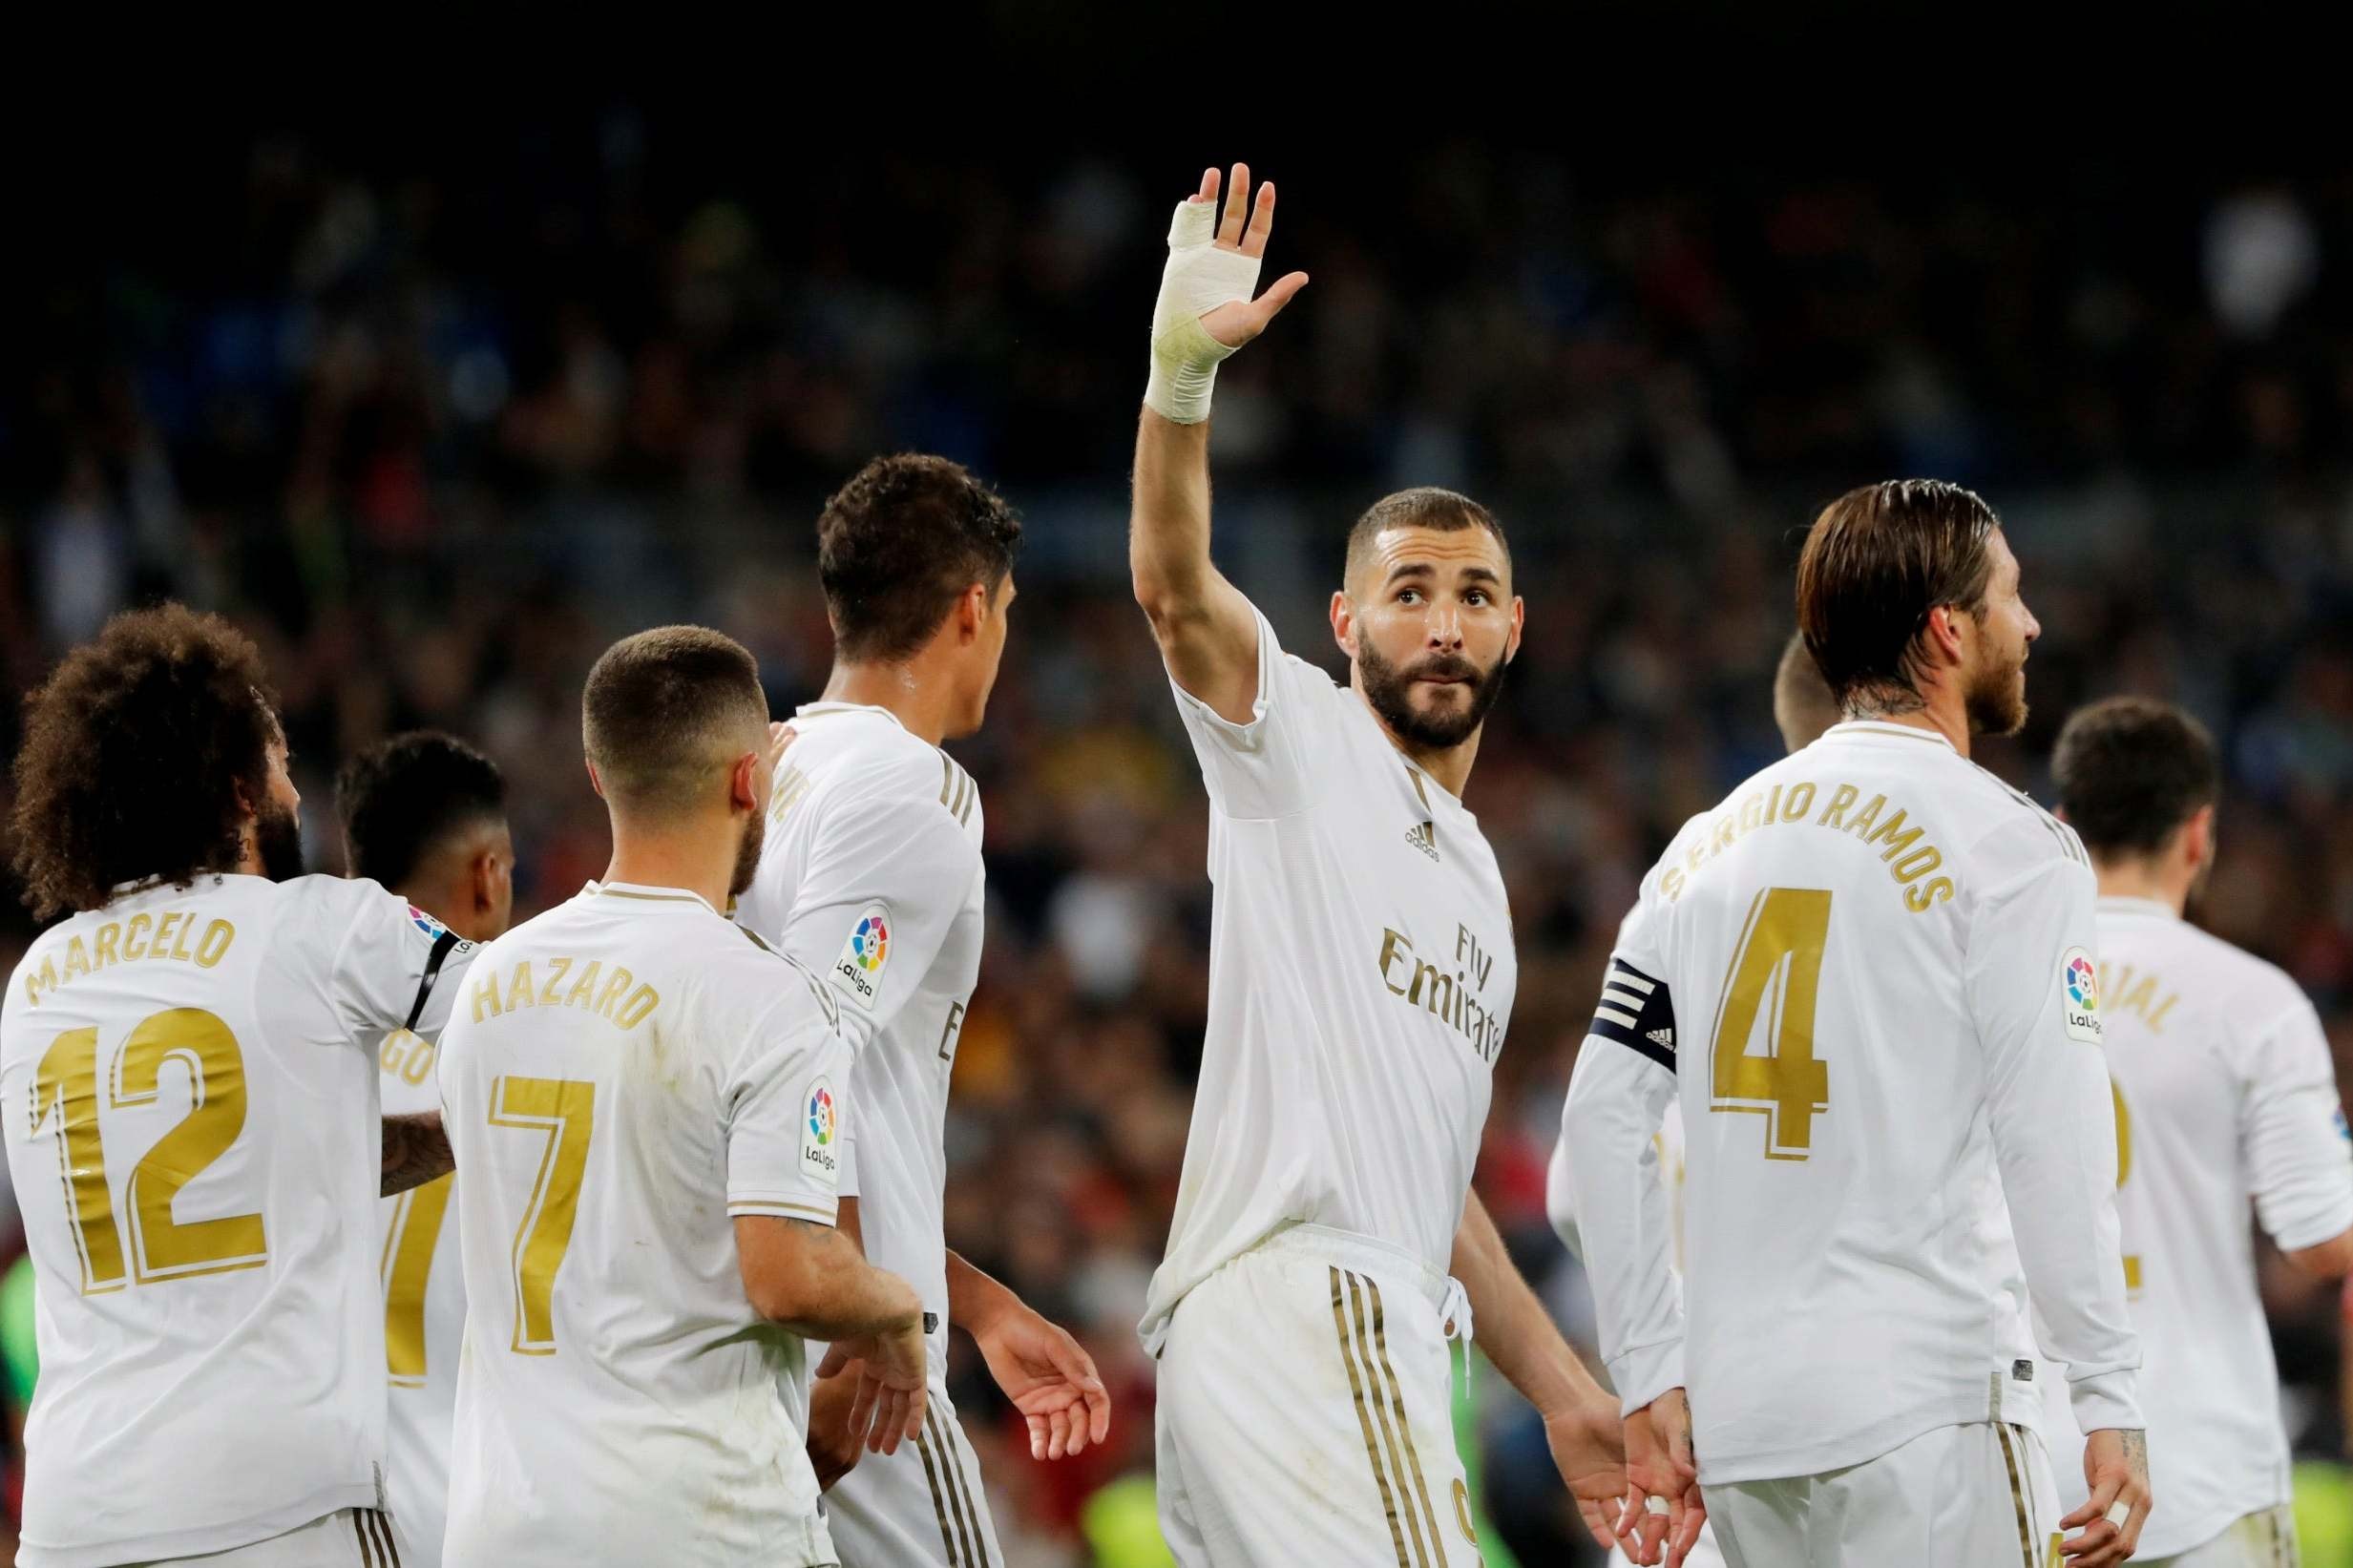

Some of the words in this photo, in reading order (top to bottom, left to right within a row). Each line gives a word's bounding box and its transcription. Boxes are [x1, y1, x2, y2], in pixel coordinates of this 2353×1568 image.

[1405, 831, 1439, 863] adidas
[1661, 782, 1817, 903] SERGIO
[1817, 784, 1954, 913] RAMOS
[24, 912, 237, 1007] MARCELO
[472, 957, 661, 1031] HAZARD
[836, 958, 872, 997] LaLiga
[1378, 927, 1500, 1062] Emirat
[1456, 922, 1493, 992] Fly
[1709, 887, 1833, 1161] 4
[2069, 1012, 2103, 1035] LaLig
[30, 1007, 268, 1298] 12
[806, 1145, 835, 1170] LaLiga
[488, 1075, 596, 1356] 7
